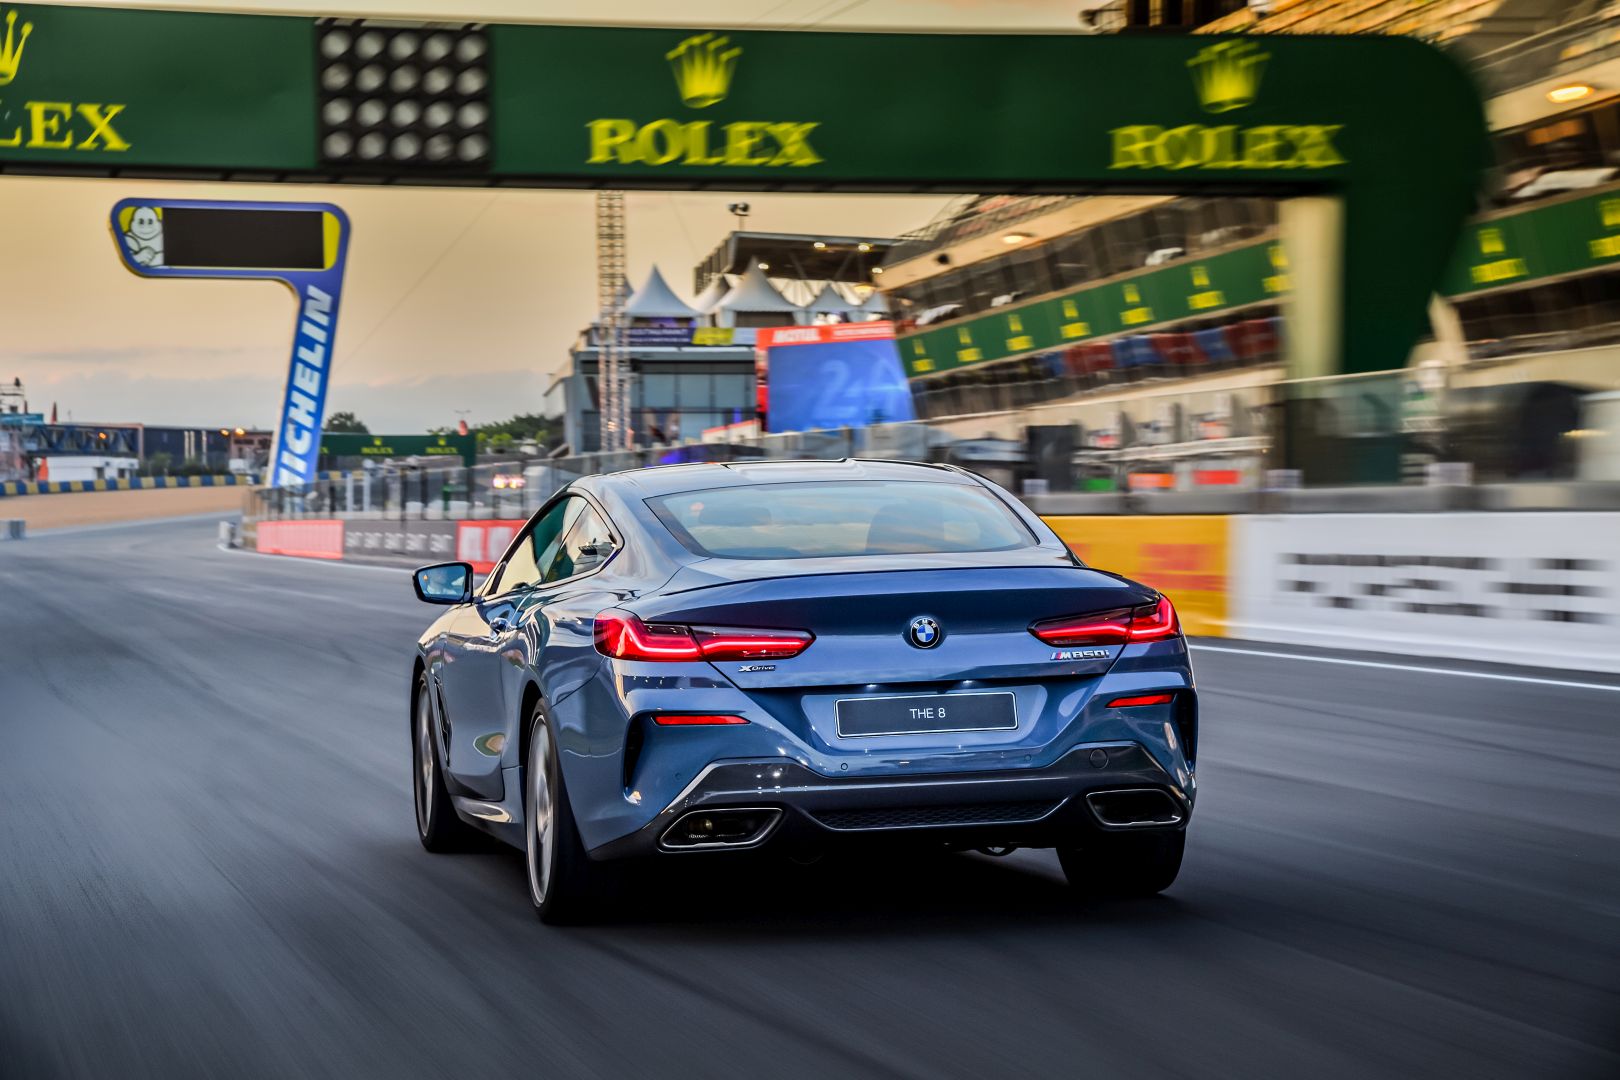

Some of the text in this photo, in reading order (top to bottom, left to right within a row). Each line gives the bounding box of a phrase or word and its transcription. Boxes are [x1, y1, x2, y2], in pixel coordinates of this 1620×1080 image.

[585, 119, 825, 166] ROLEX
[1107, 124, 1349, 169] ROLEX
[912, 618, 937, 629] BMW
[909, 707, 946, 719] THE 8
